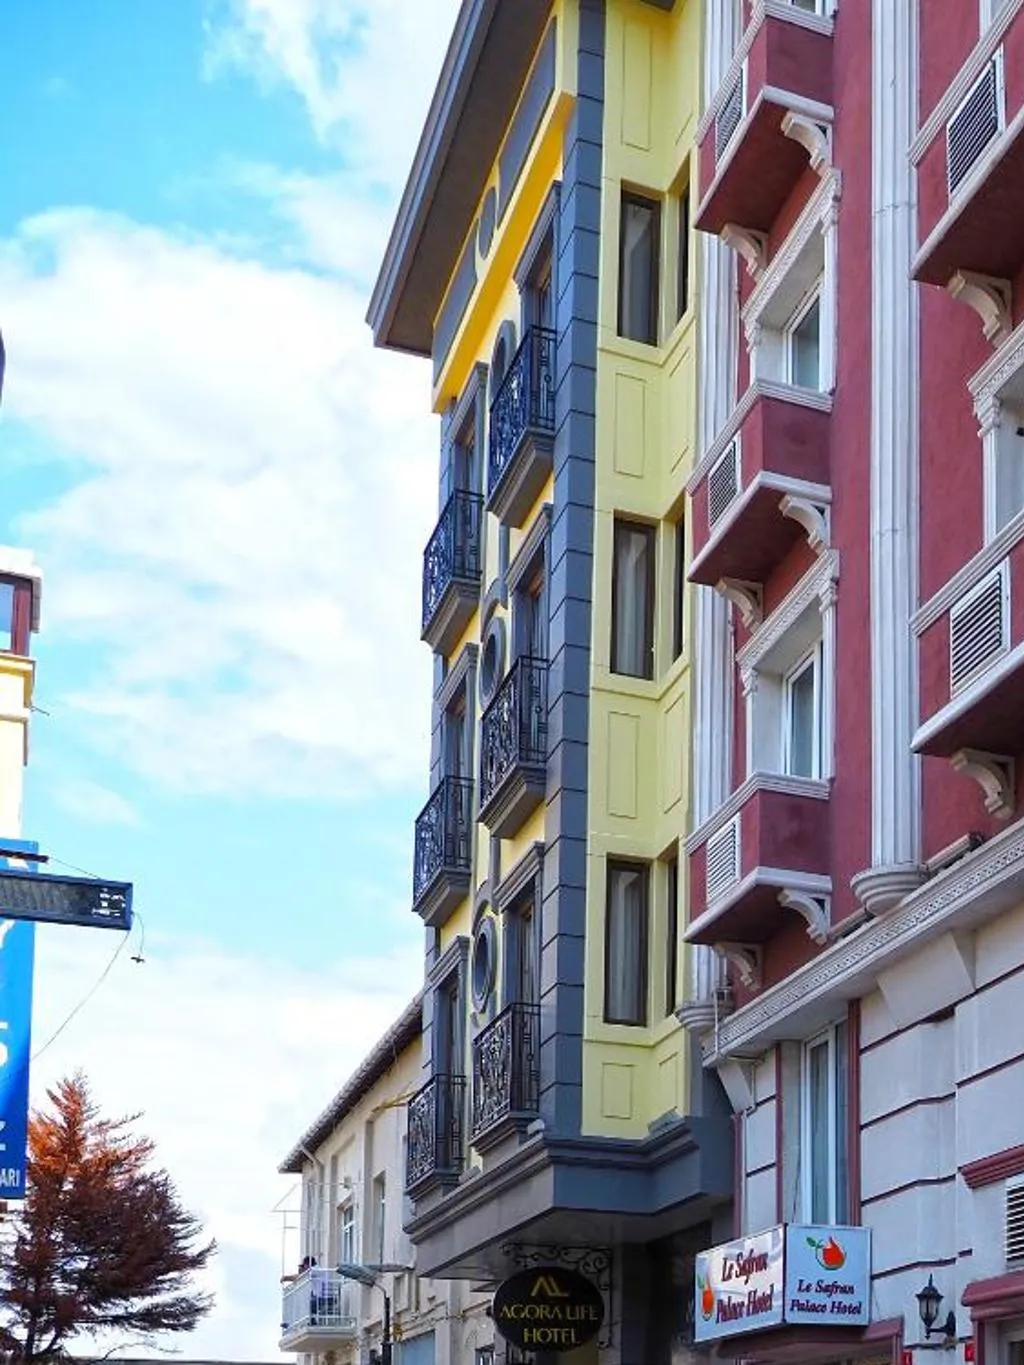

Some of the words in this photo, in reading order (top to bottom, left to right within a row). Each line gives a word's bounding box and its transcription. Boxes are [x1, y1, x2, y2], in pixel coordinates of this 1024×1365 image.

[722, 1256, 735, 1283] Le
[797, 1278, 813, 1293] Le
[814, 1279, 855, 1301] Safran
[747, 1283, 775, 1318] Hotel
[789, 1299, 828, 1315] Palace
[829, 1301, 863, 1316] Hotel
[500, 1304, 563, 1319] AGORA
[566, 1304, 599, 1320] LIFE
[523, 1327, 577, 1343] HOTEL
